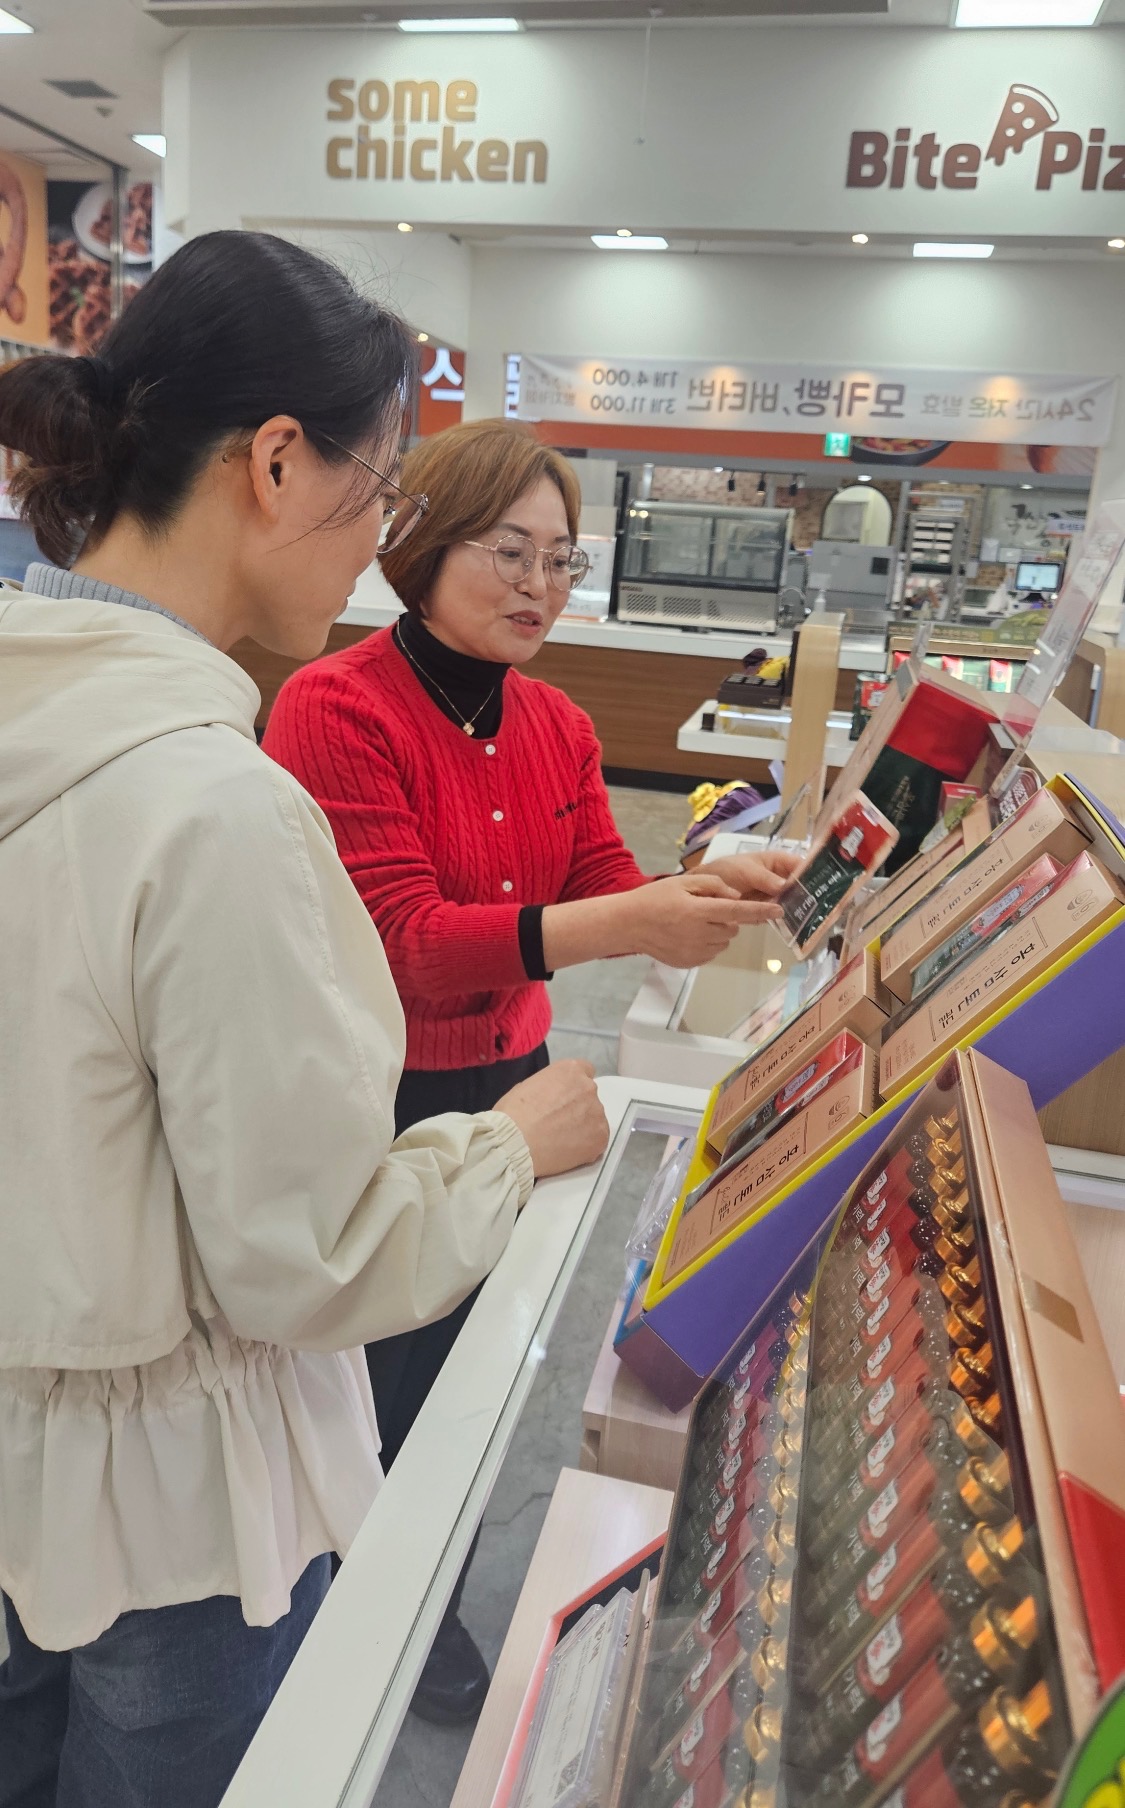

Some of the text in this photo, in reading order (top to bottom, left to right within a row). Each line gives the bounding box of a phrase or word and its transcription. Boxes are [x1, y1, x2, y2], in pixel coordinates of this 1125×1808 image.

[327, 78, 477, 121] some
[326, 125, 548, 183] chicken
[846, 128, 981, 189] Bite
